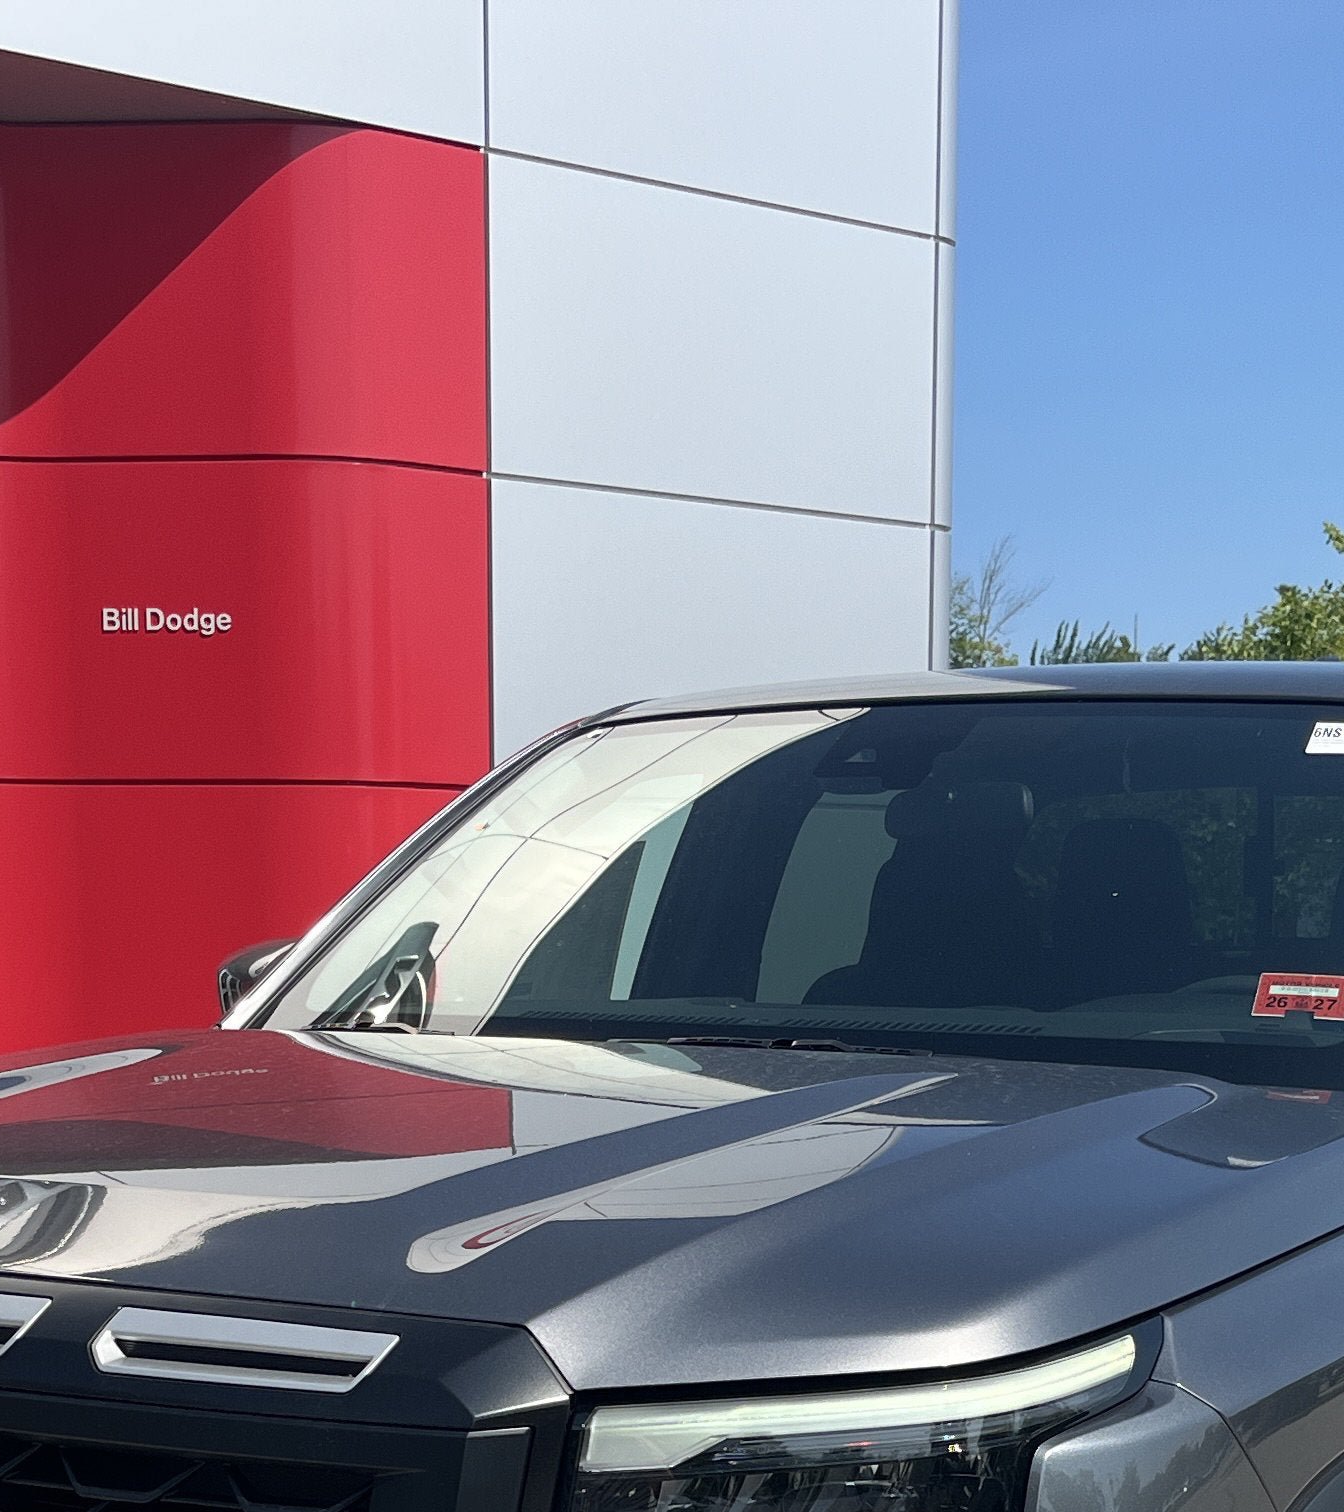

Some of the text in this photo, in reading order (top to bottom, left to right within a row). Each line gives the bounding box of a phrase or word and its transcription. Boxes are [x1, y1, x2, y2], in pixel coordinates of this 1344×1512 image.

[102, 607, 232, 635] Bill Dodge
[1265, 996, 1338, 1011] 26 27
